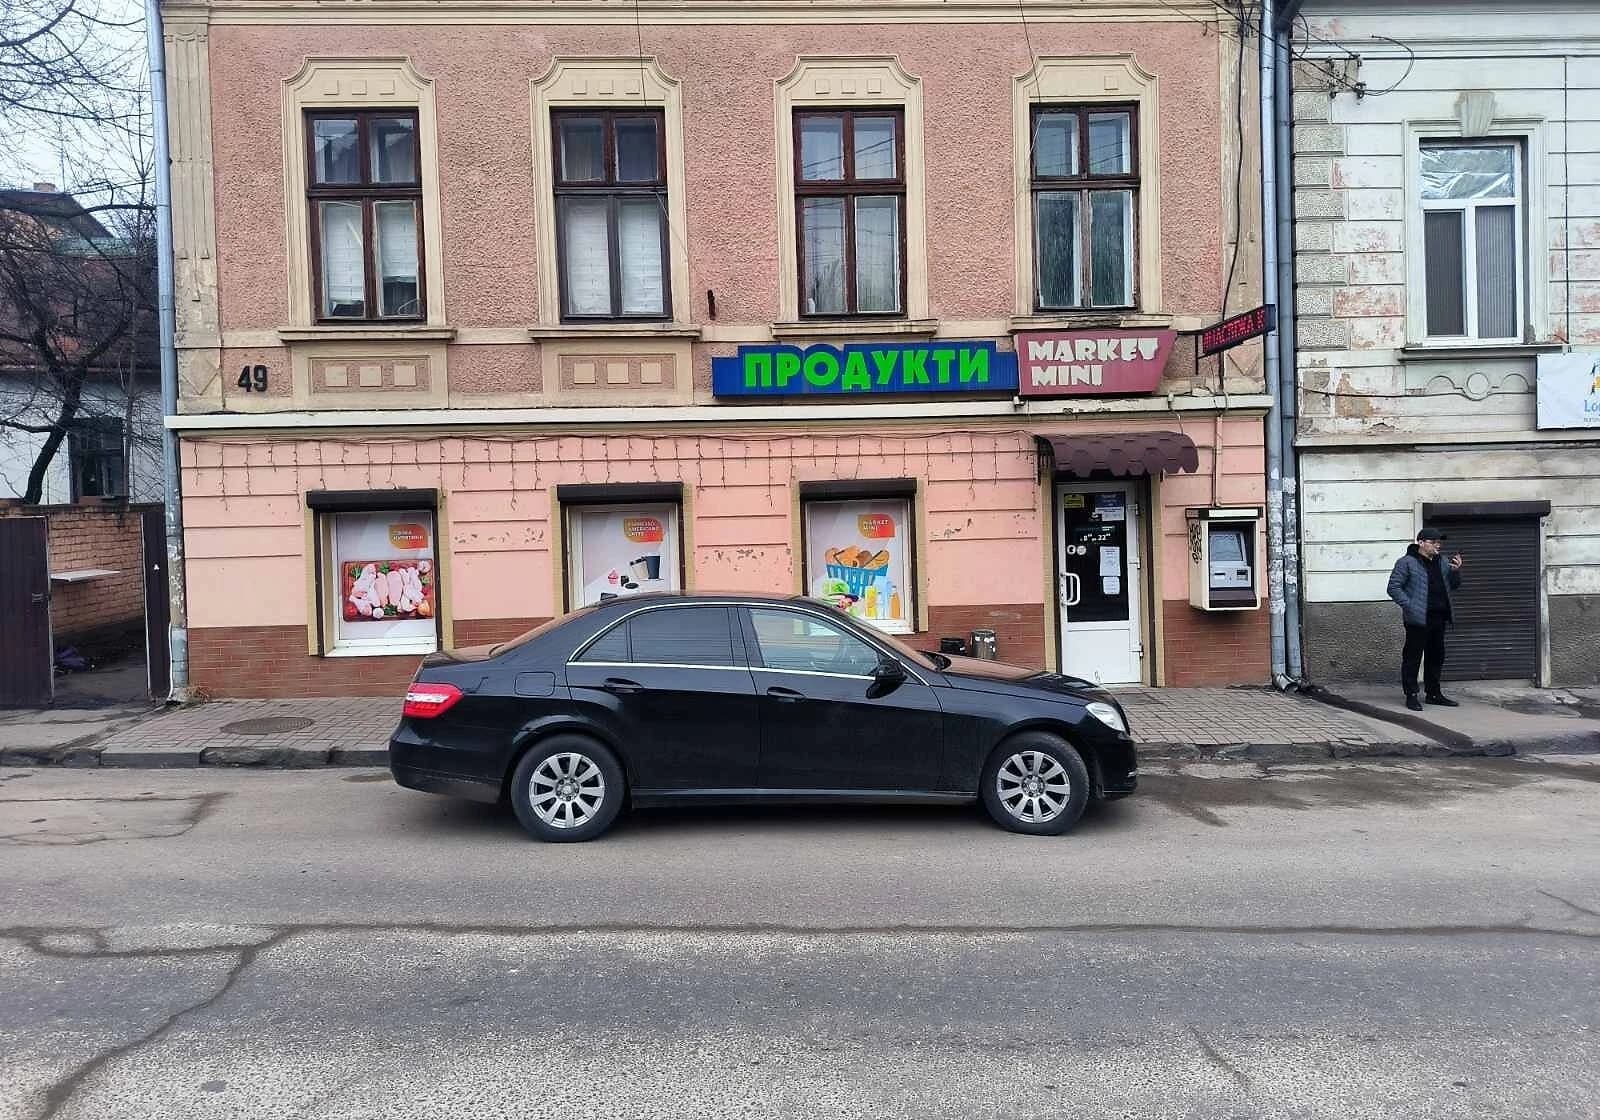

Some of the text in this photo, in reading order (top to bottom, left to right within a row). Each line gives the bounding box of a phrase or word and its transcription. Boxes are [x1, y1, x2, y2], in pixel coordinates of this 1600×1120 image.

[1027, 337, 1158, 362] MARKET
[238, 364, 267, 392] 49
[744, 348, 989, 391] ПРОДУКТИ
[1031, 364, 1104, 386] MINI
